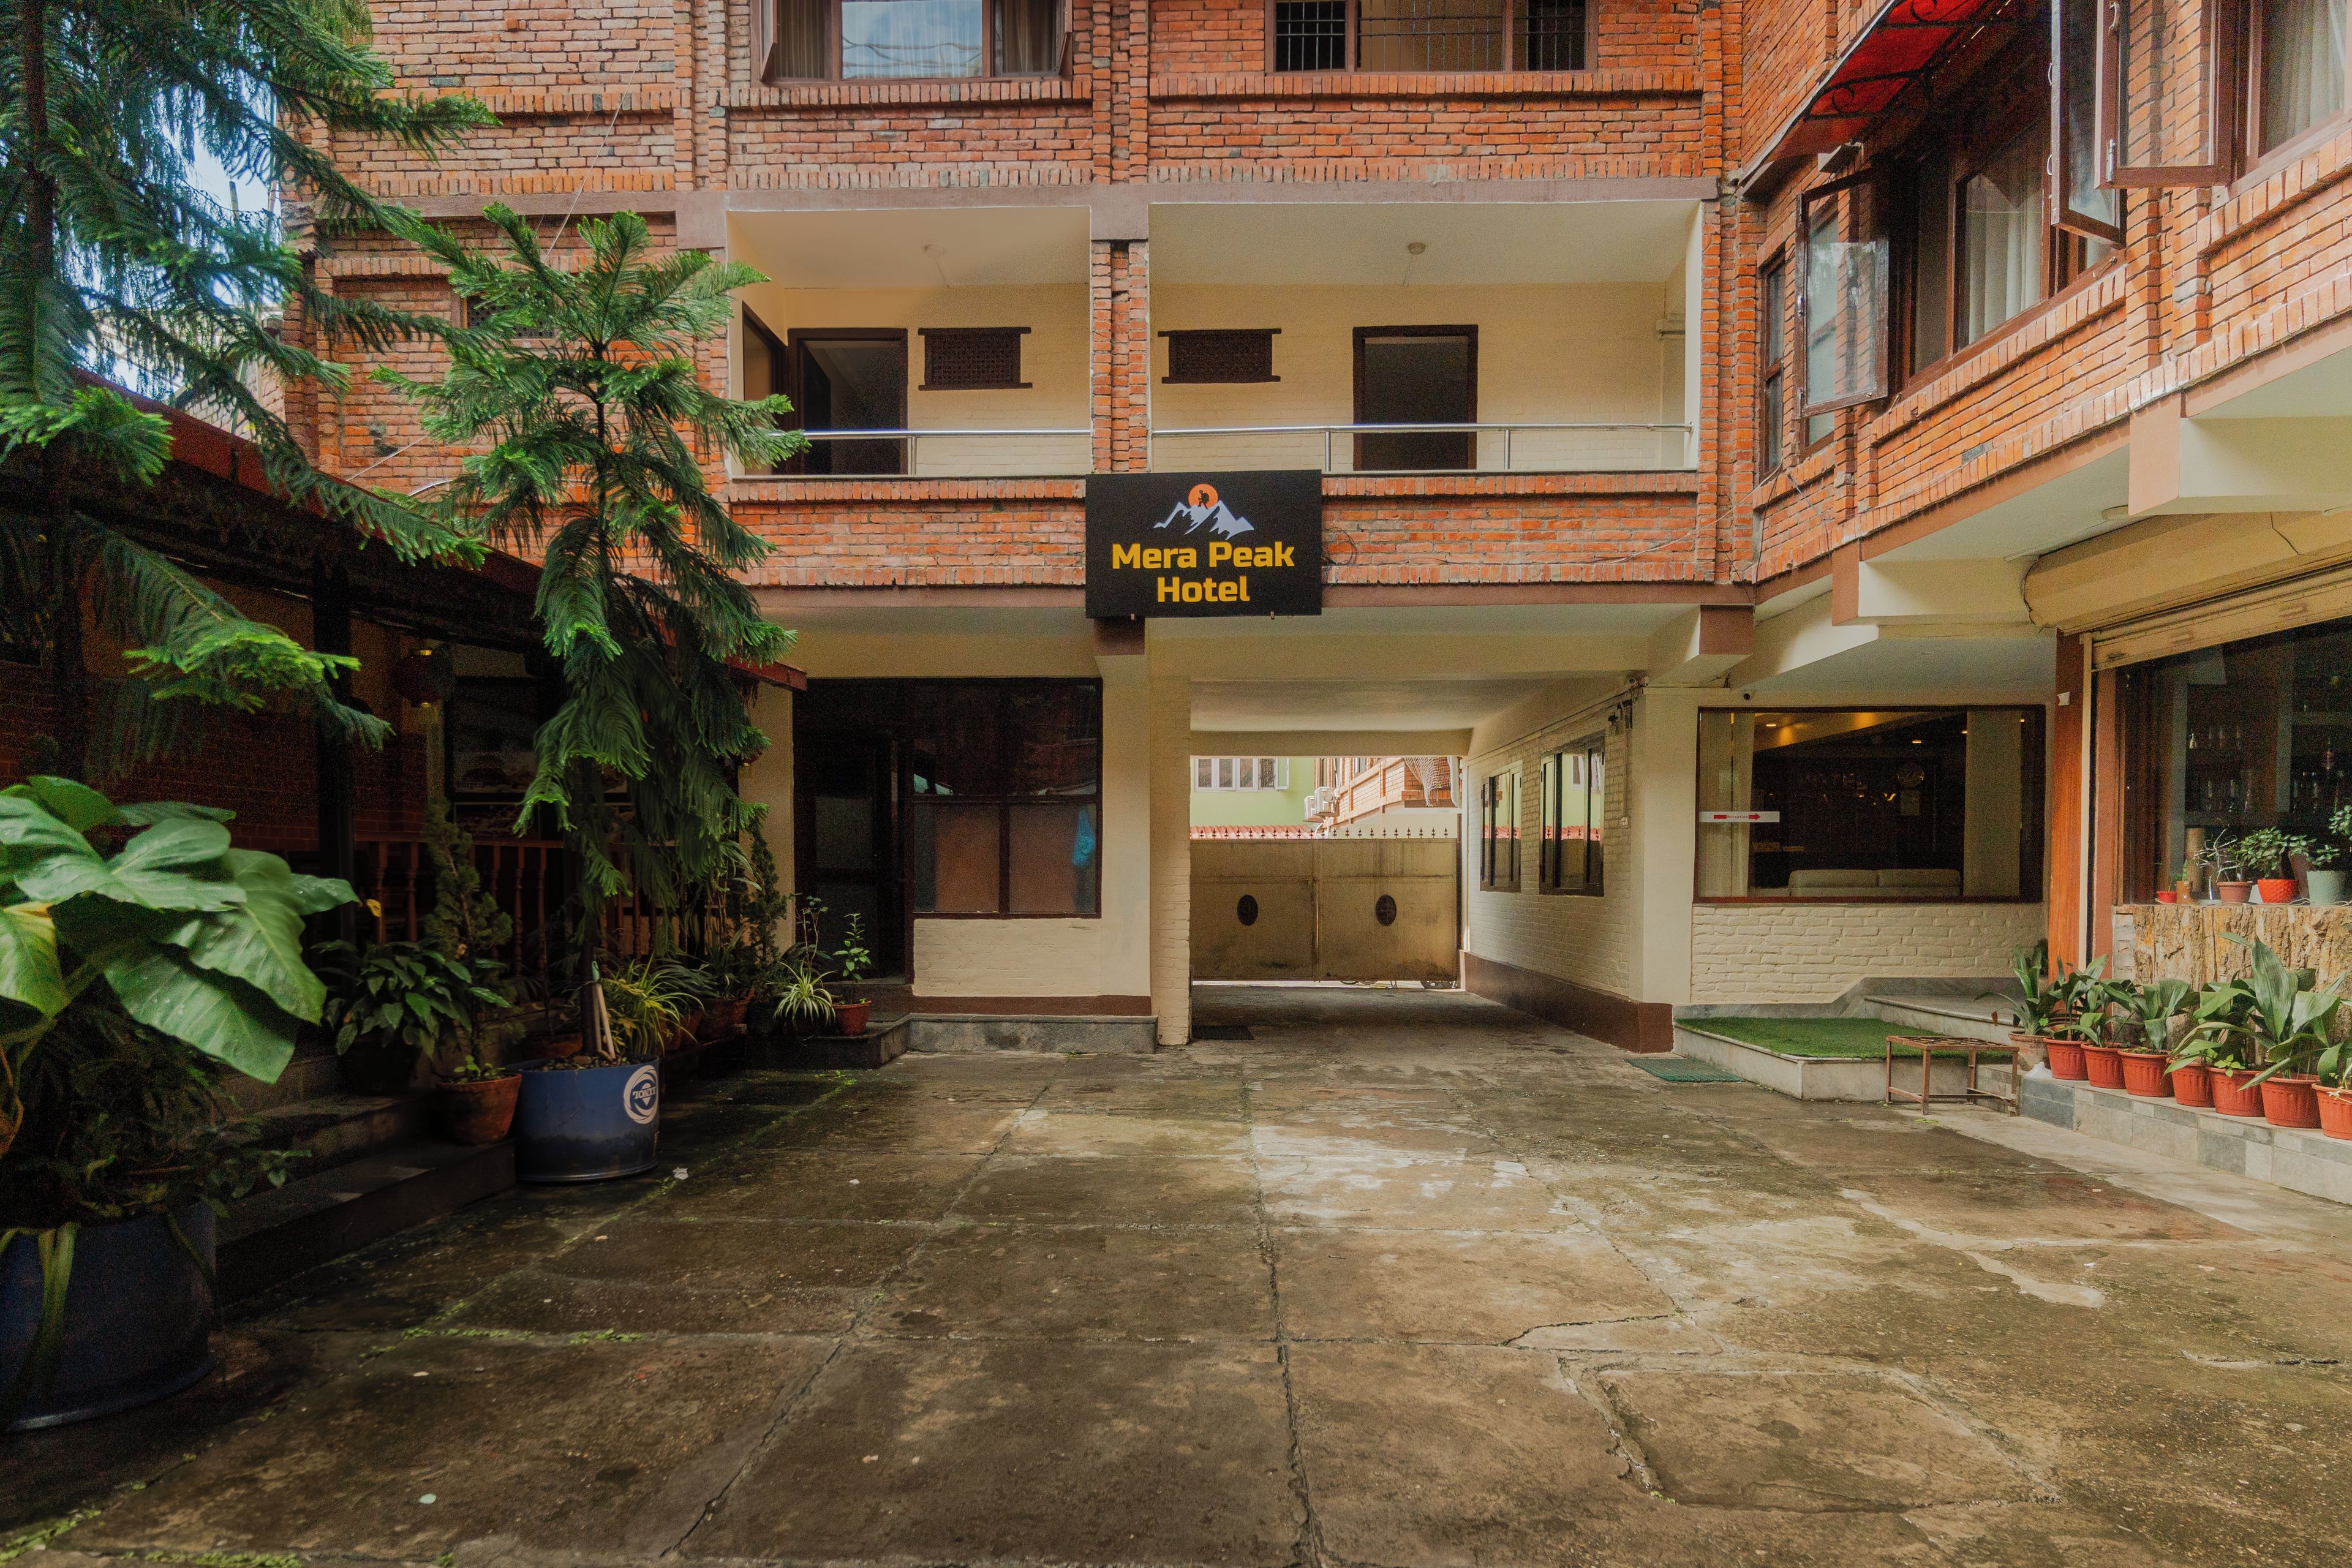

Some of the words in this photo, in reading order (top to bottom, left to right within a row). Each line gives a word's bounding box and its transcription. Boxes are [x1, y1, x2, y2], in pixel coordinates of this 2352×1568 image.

[1112, 543, 1197, 569] Mera
[1208, 541, 1295, 568] Peak
[1157, 575, 1250, 603] Hotel
